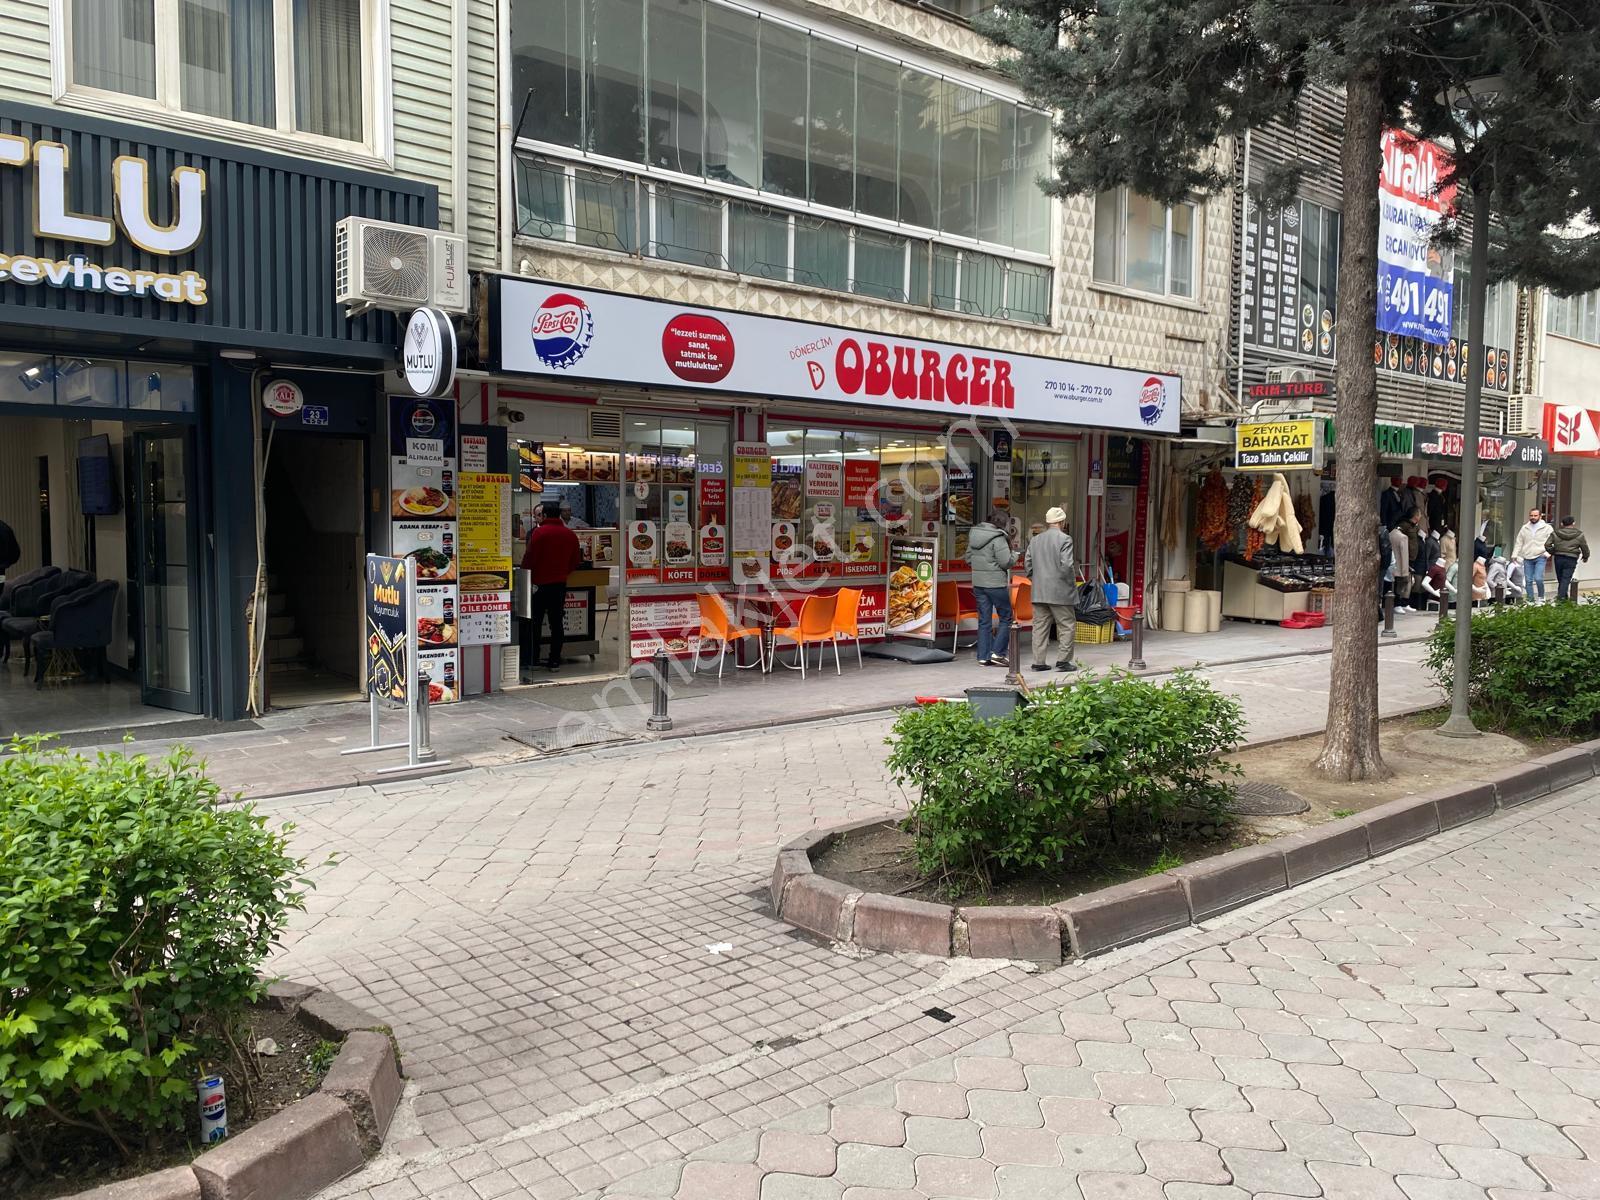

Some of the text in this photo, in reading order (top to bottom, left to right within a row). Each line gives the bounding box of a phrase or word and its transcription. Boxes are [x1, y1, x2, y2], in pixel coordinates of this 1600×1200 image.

[1391, 277, 1420, 316] 491
[1424, 287, 1449, 326] 491
[698, 332, 726, 341] sunmak
[688, 341, 710, 351] sanat,
[407, 354, 433, 369] MUTLU
[680, 350, 718, 360] tatmak ise
[835, 337, 1015, 409] OBURGER
[1045, 380, 1058, 390] 270
[1059, 382, 1067, 391] 10
[1068, 383, 1075, 392] 14
[1080, 385, 1093, 394] 270
[1094, 386, 1102, 395] 72
[1103, 387, 1112, 396] 00
[274, 391, 295, 400] KALE
[309, 410, 320, 419] 23
[1253, 425, 1298, 435] ZEYNEP
[1242, 434, 1309, 448] BAHARAT
[1441, 432, 1502, 458] FENMEN
[1241, 451, 1309, 465] Taze Tahin Çekilir
[1521, 446, 1543, 465] GİRİŞ
[668, 570, 693, 579] KÖFTE
[374, 584, 400, 605] Mutlu
[373, 604, 400, 618] Kuyumculuk
[858, 624, 884, 636] ERVİ
